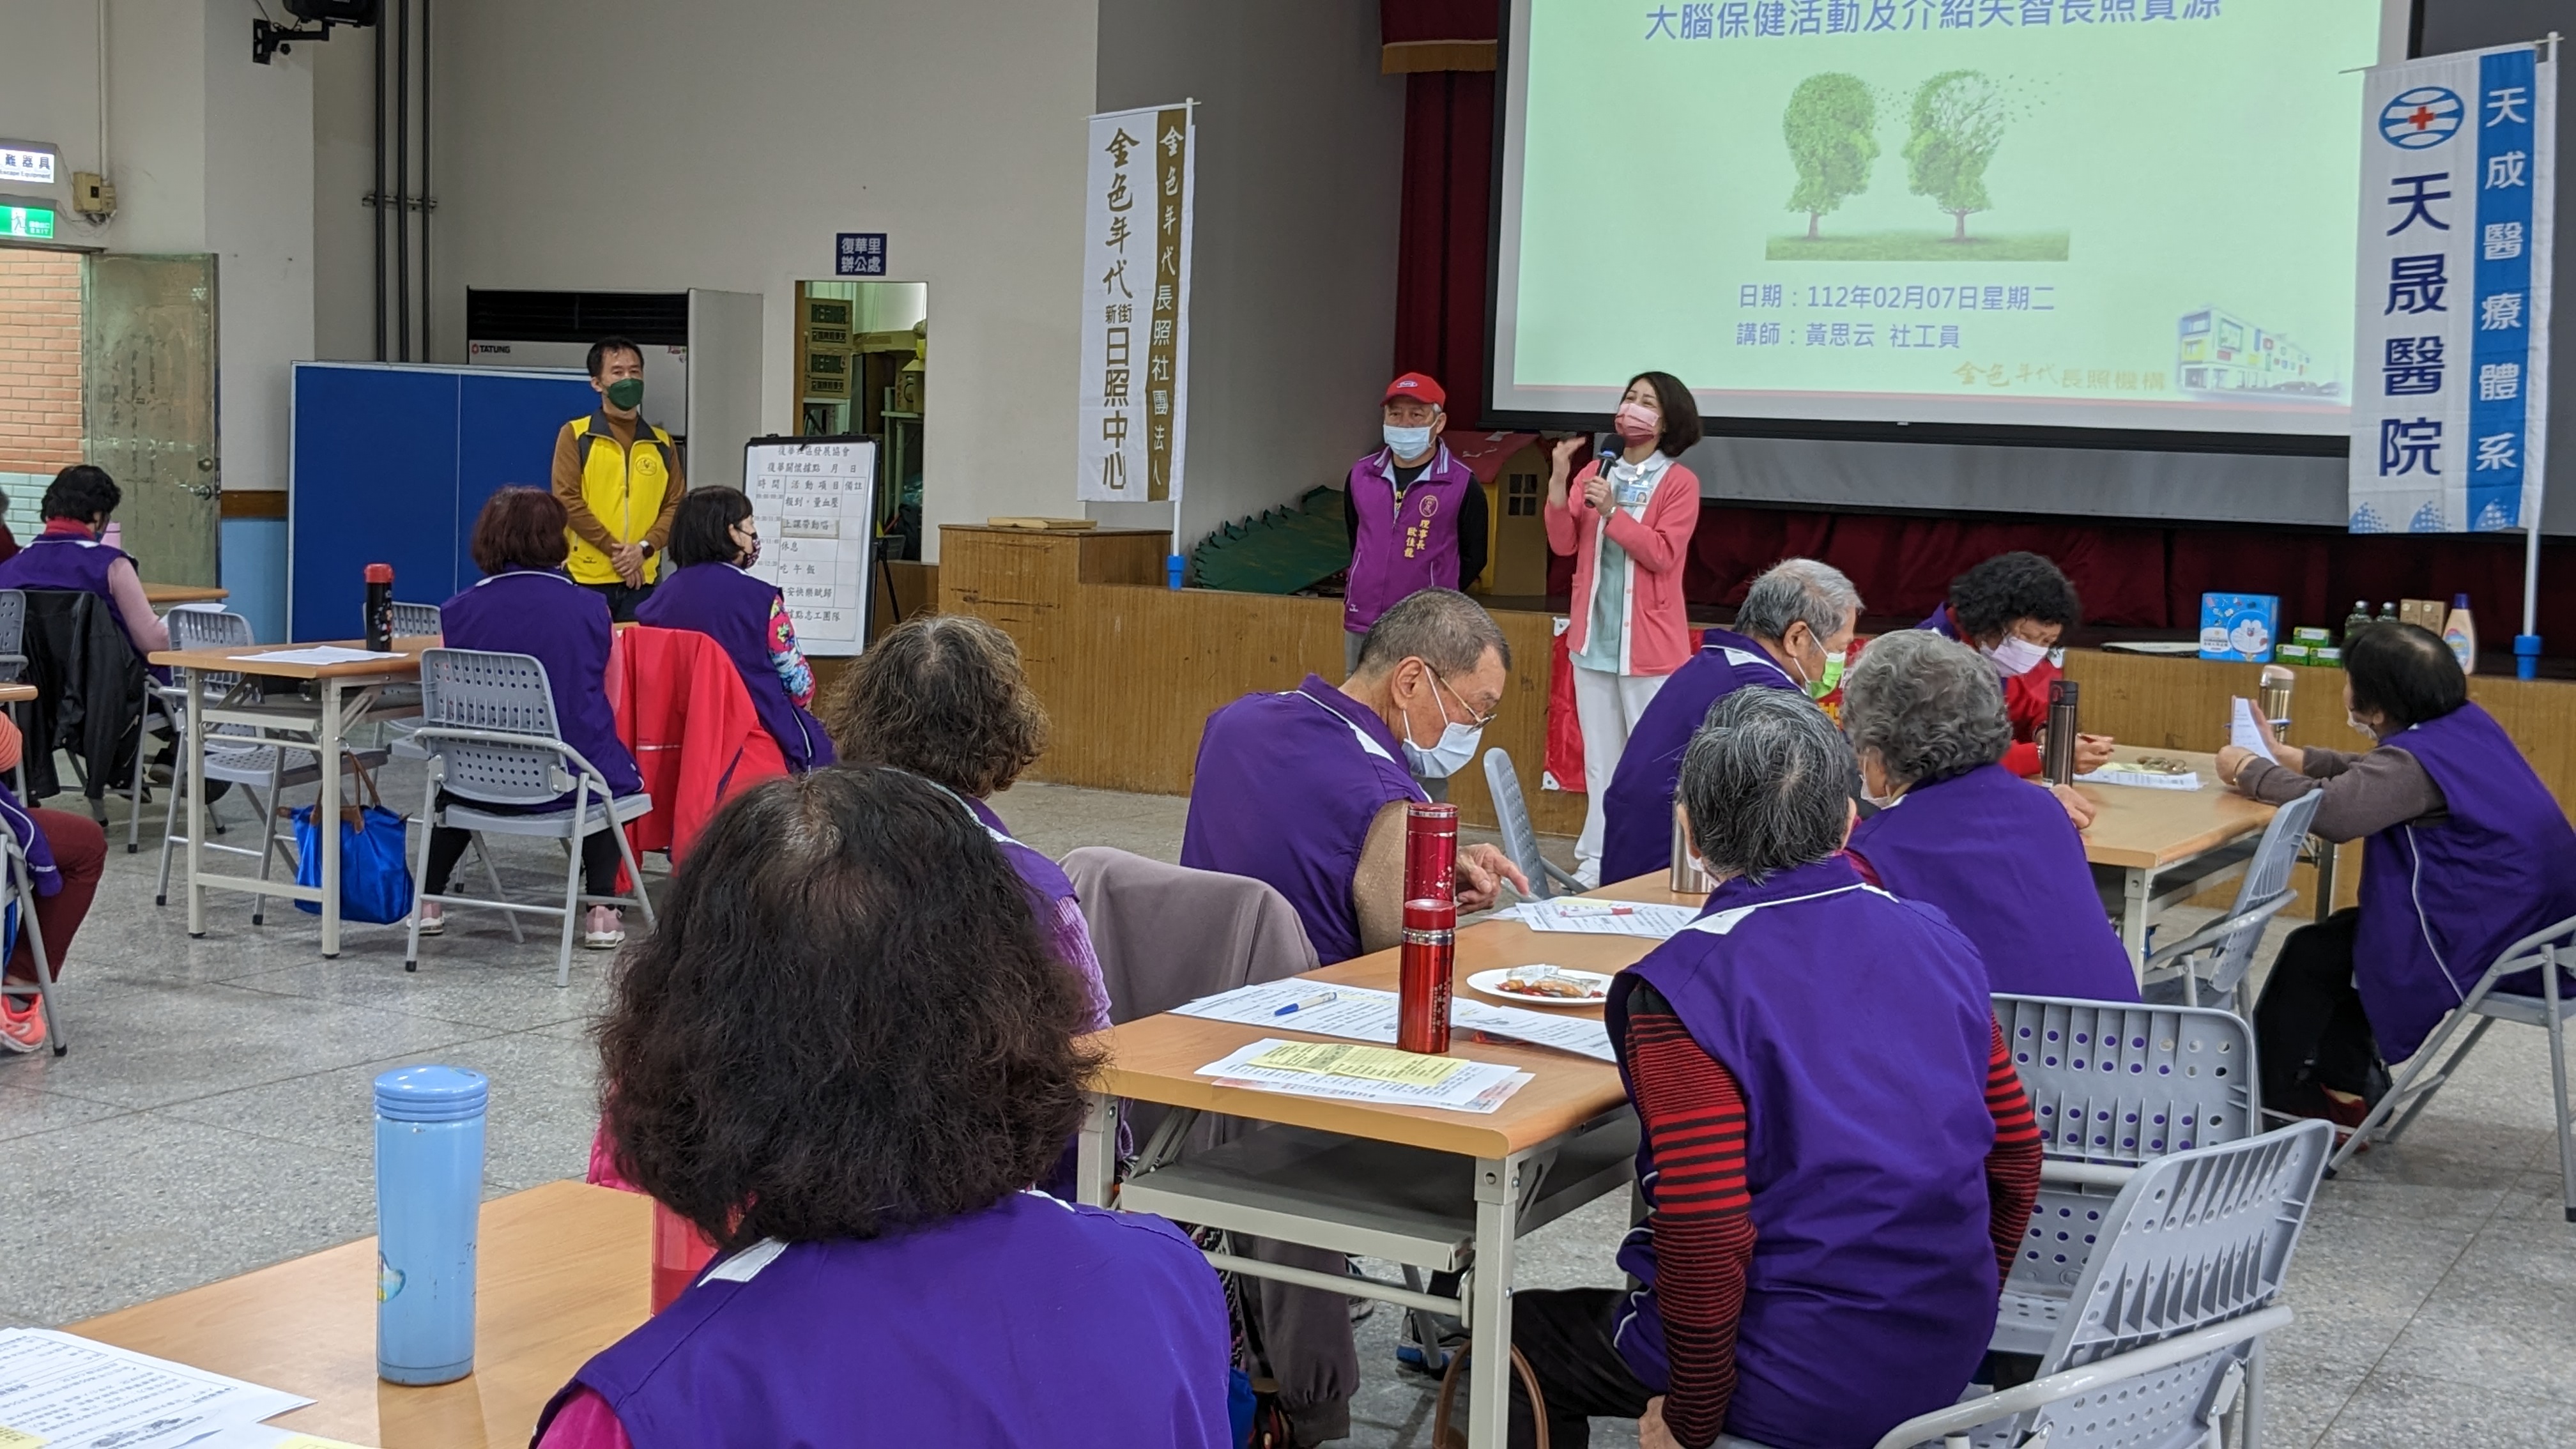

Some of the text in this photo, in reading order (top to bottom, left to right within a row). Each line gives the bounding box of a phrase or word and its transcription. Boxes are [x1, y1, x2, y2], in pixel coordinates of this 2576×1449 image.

[841, 238, 881, 254] 復華里
[841, 256, 881, 273] 辦公處
[2476, 86, 2527, 471] 天成醫療體系
[2379, 172, 2453, 477] 天晟醫院
[1889, 324, 1960, 349] 社工員
[479, 345, 510, 354] TATUNG
[831, 464, 838, 473] 月
[850, 464, 856, 473] 日
[781, 541, 799, 552] 休息
